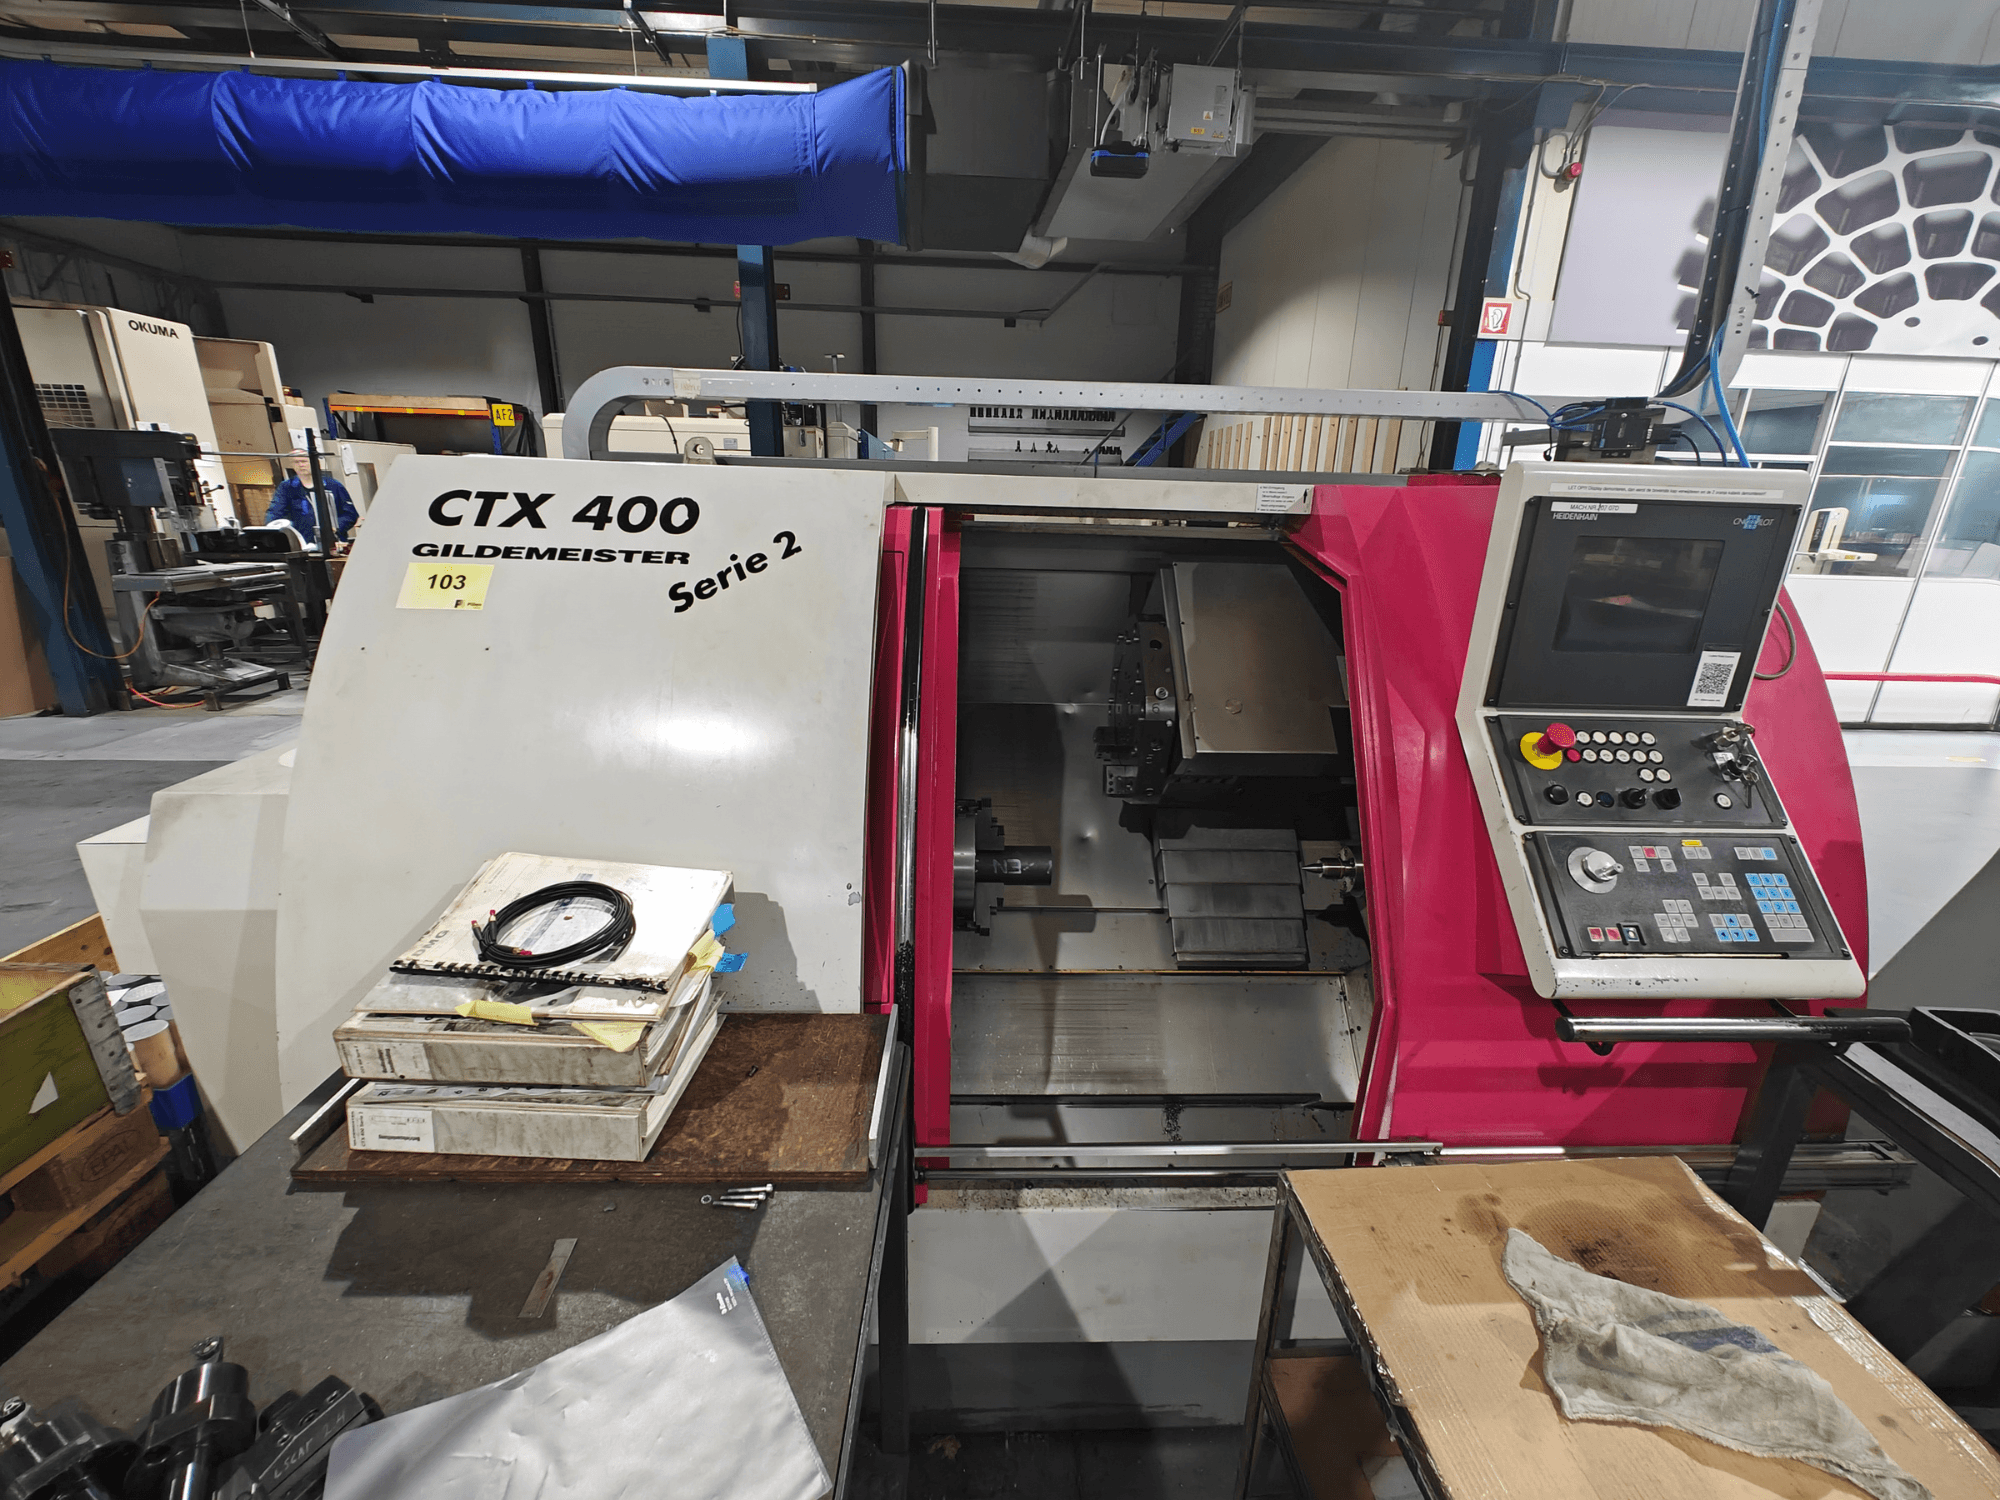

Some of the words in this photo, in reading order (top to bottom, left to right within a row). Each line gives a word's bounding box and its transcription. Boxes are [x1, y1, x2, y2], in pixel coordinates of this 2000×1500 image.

[127, 319, 180, 340] OKUMA
[428, 488, 556, 530] CTX
[571, 494, 701, 535] 400
[1552, 512, 1599, 521] HEIDENHAIN
[411, 542, 691, 566] GILDEMEISTER
[427, 573, 467, 591] 103
[667, 552, 769, 614] Serie
[772, 530, 803, 561] 2
[413, 929, 451, 958] DMG
